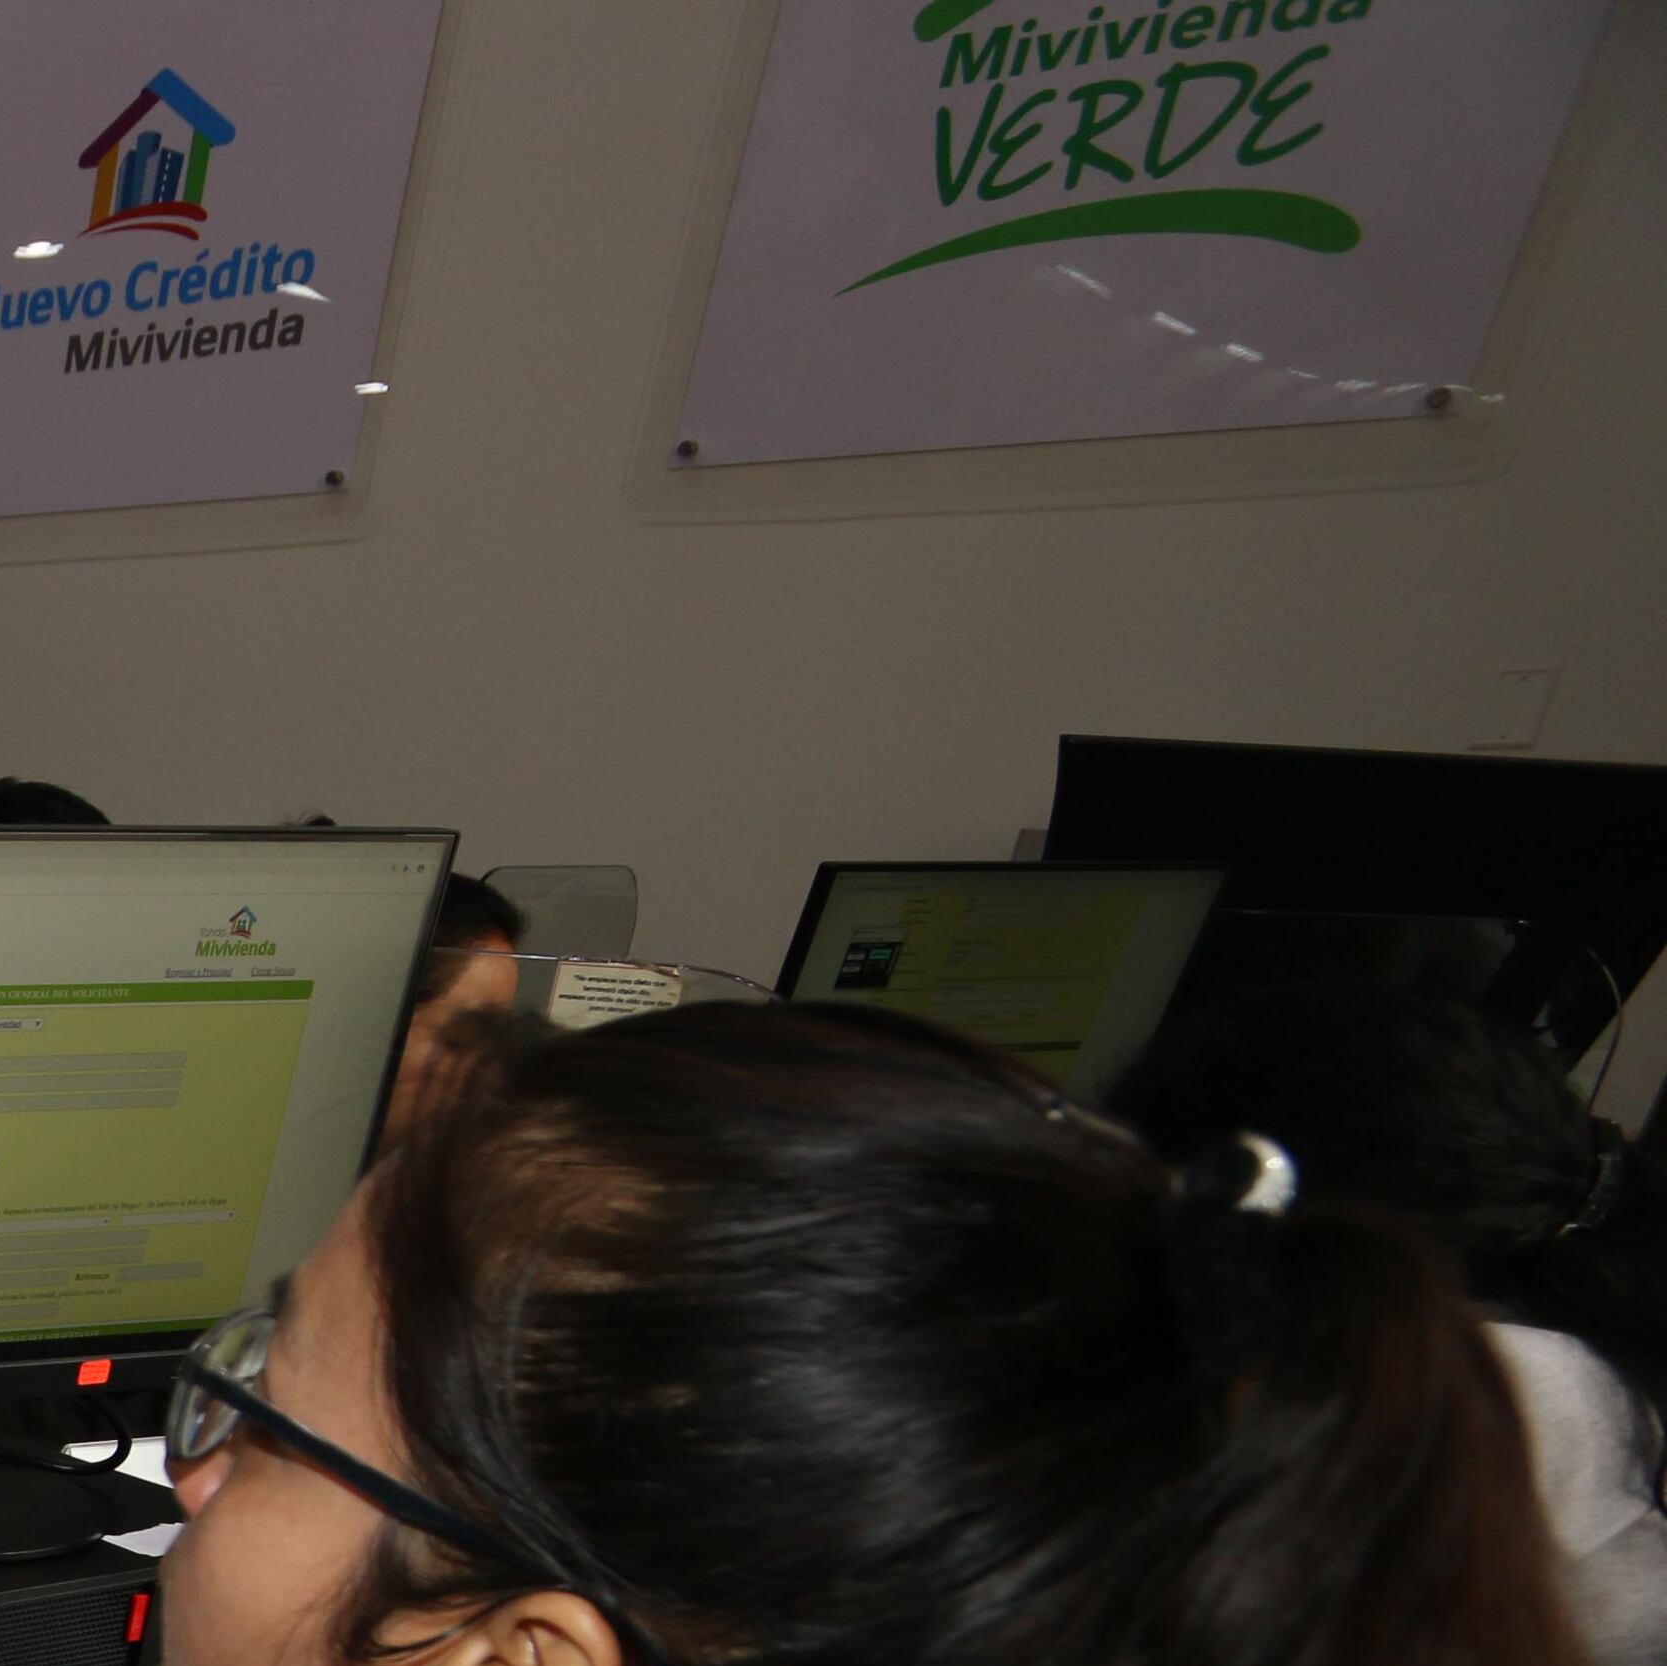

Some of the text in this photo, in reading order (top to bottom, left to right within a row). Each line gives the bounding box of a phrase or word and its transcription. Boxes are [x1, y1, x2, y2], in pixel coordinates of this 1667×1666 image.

[940, 0, 1373, 89] Mivivienda
[935, 44, 1330, 208] VERDE
[125, 245, 315, 314] Crédito
[64, 310, 306, 375] Mivivienda
[195, 940, 276, 957] Mivivienda
[8, 989, 49, 999] GENERAL
